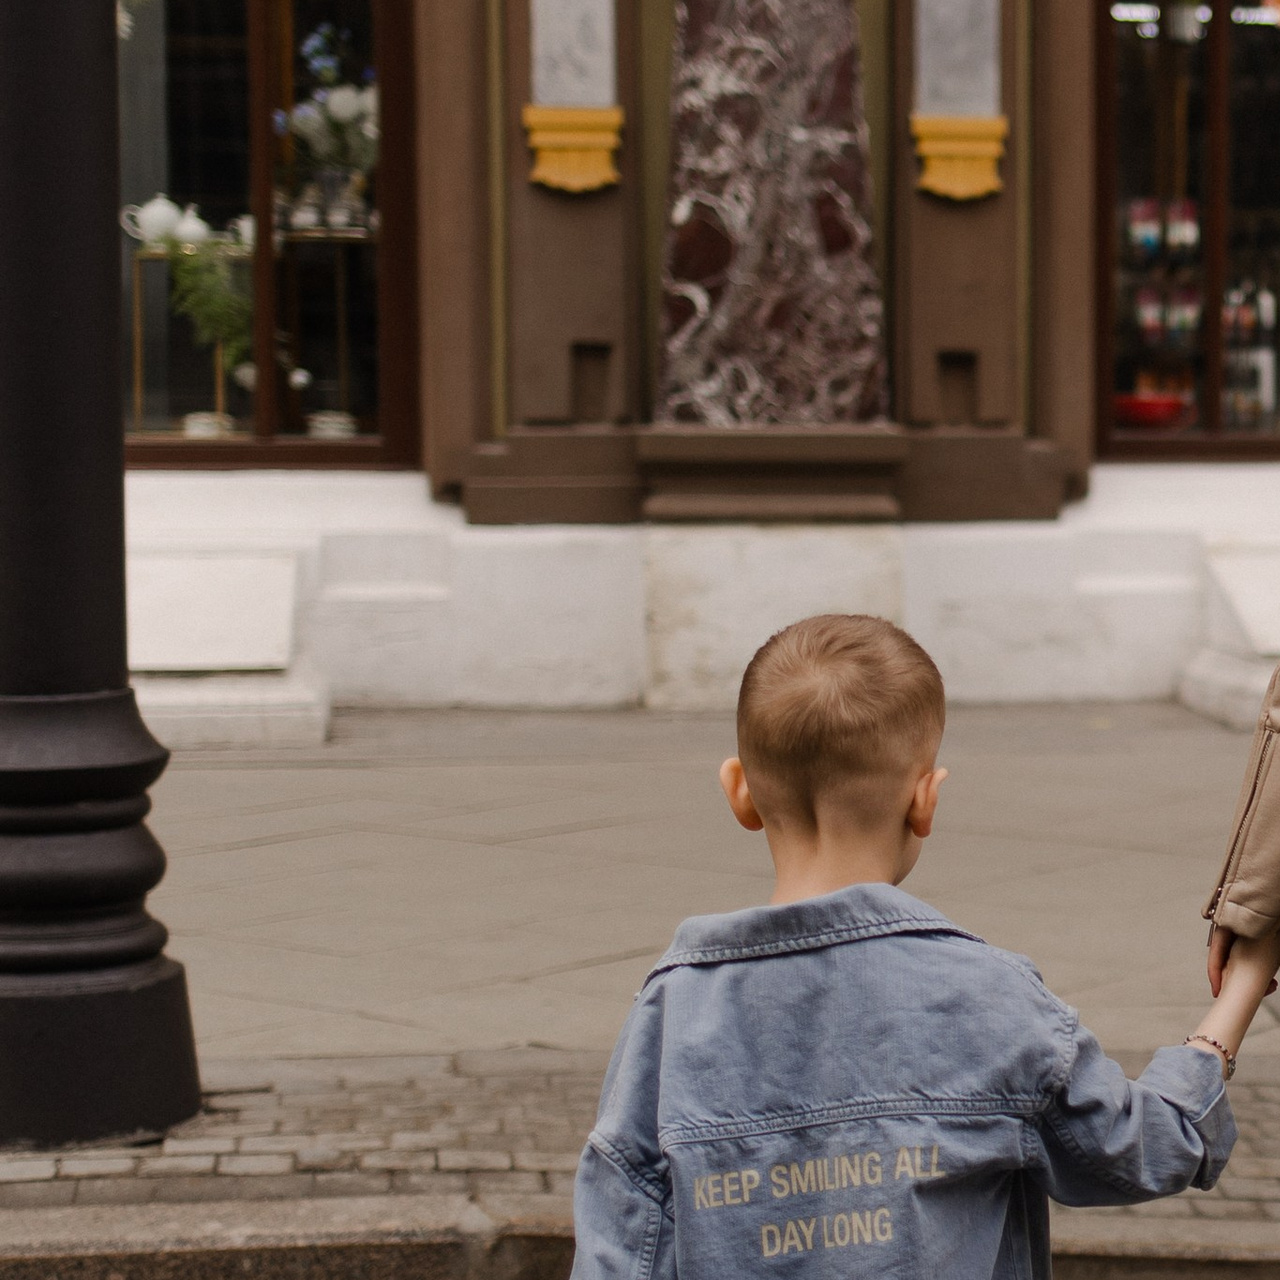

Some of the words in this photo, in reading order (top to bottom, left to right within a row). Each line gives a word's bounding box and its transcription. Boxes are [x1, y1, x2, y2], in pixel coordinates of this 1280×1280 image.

[693, 1170, 760, 1210] KEEP
[770, 1151, 882, 1199] SMILING
[895, 1145, 946, 1179] ALL
[761, 1218, 816, 1257] DAY
[822, 1208, 893, 1248] LONG
